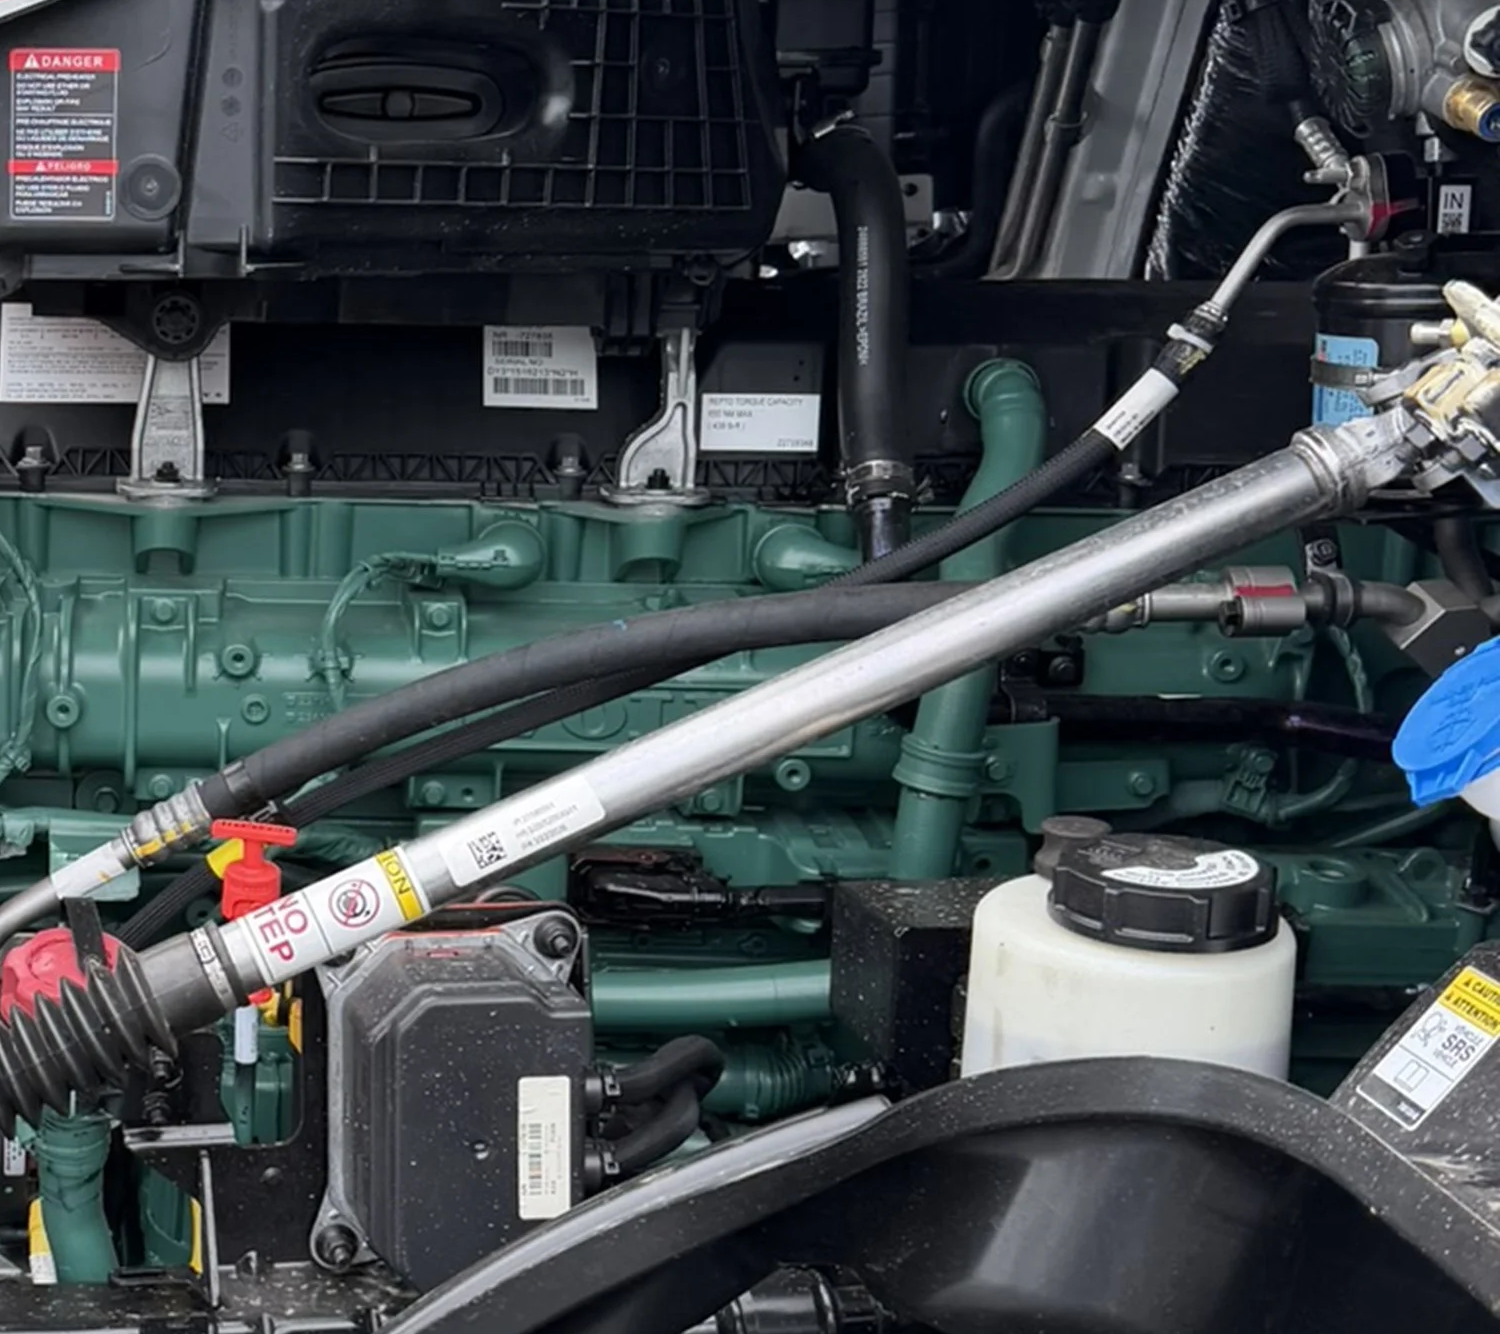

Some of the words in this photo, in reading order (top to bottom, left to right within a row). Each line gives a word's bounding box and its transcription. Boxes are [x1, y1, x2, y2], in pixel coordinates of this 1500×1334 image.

[41, 55, 104, 68] DANGER
[47, 162, 92, 171] PELIGRO
[1444, 192, 1464, 209] IN
[735, 397, 765, 406] TORQUE
[767, 397, 803, 406] CAPACITY
[380, 853, 411, 895] ION
[253, 906, 295, 963] TEP
[1441, 1033, 1476, 1063] SRS
